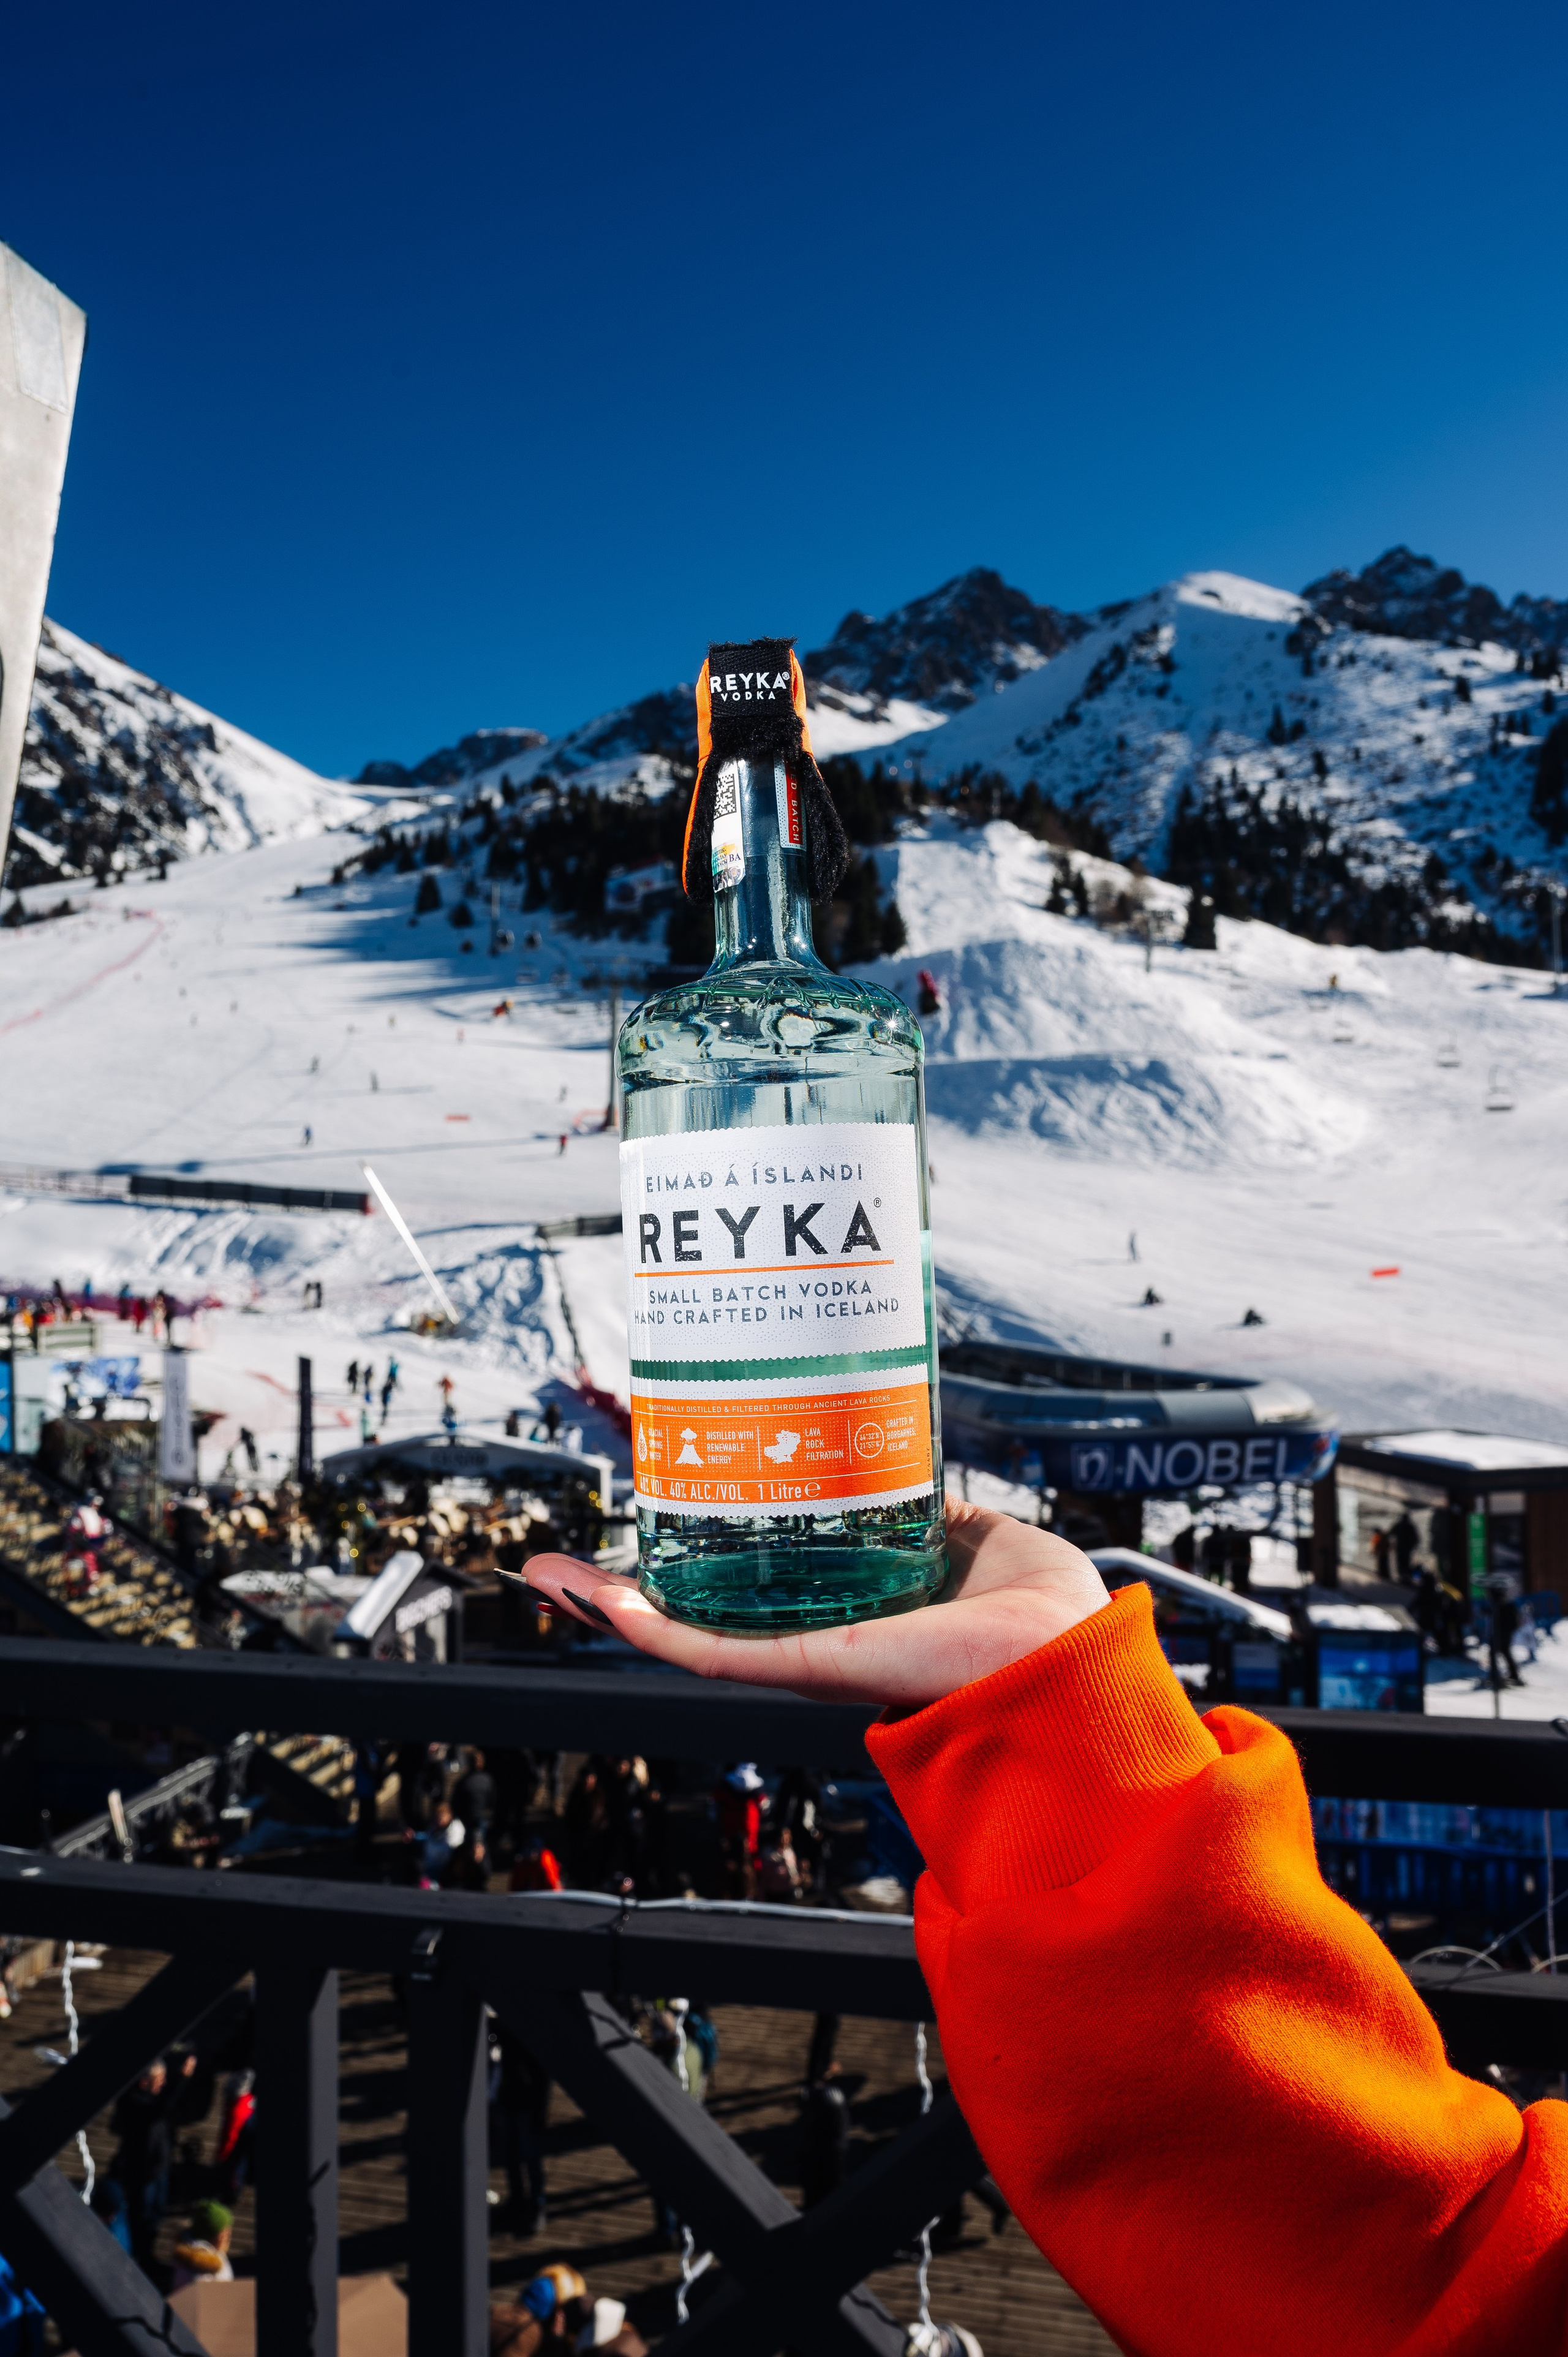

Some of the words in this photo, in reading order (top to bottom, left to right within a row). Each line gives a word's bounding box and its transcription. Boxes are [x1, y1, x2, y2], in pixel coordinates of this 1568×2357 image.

[721, 691, 775, 702] VODKA
[729, 853, 741, 862] BA
[647, 1171, 713, 1193] EIMAÐ
[725, 1162, 739, 1187] Á
[752, 1162, 862, 1185] ÍSLANDI
[650, 1289, 701, 1305] SMALL
[712, 1284, 786, 1303] BATCH
[799, 1280, 872, 1298] VODKA
[635, 1310, 665, 1324] HAND
[673, 1307, 767, 1324] CRAFTED
[780, 1305, 803, 1321] IN
[816, 1299, 899, 1319] ICELAND
[646, 1403, 684, 1412] TRADITIONALLY
[813, 1399, 847, 1408] ANCIENT
[850, 1397, 867, 1406] LAVA
[886, 1417, 907, 1428] CRAFTED
[909, 1416, 913, 1424] IN
[706, 1431, 736, 1440] DISTILLED
[738, 1431, 754, 1439] WITH
[805, 1428, 821, 1436] LAVA
[707, 1443, 745, 1452] RENEWABLE
[805, 1439, 824, 1448] ROCK
[888, 1440, 908, 1451] ICELAND
[707, 1455, 731, 1464] ENERGY
[806, 1450, 843, 1461] FILTRATION
[1123, 1438, 1289, 1488] NOBEL
[639, 1476, 649, 1493] 40%
[650, 1479, 667, 1497] VOL.
[669, 1482, 687, 1499] 40%
[690, 1482, 748, 1501] ALC./VOL.
[758, 1483, 764, 1500] 1
[771, 1482, 802, 1500] Litre
